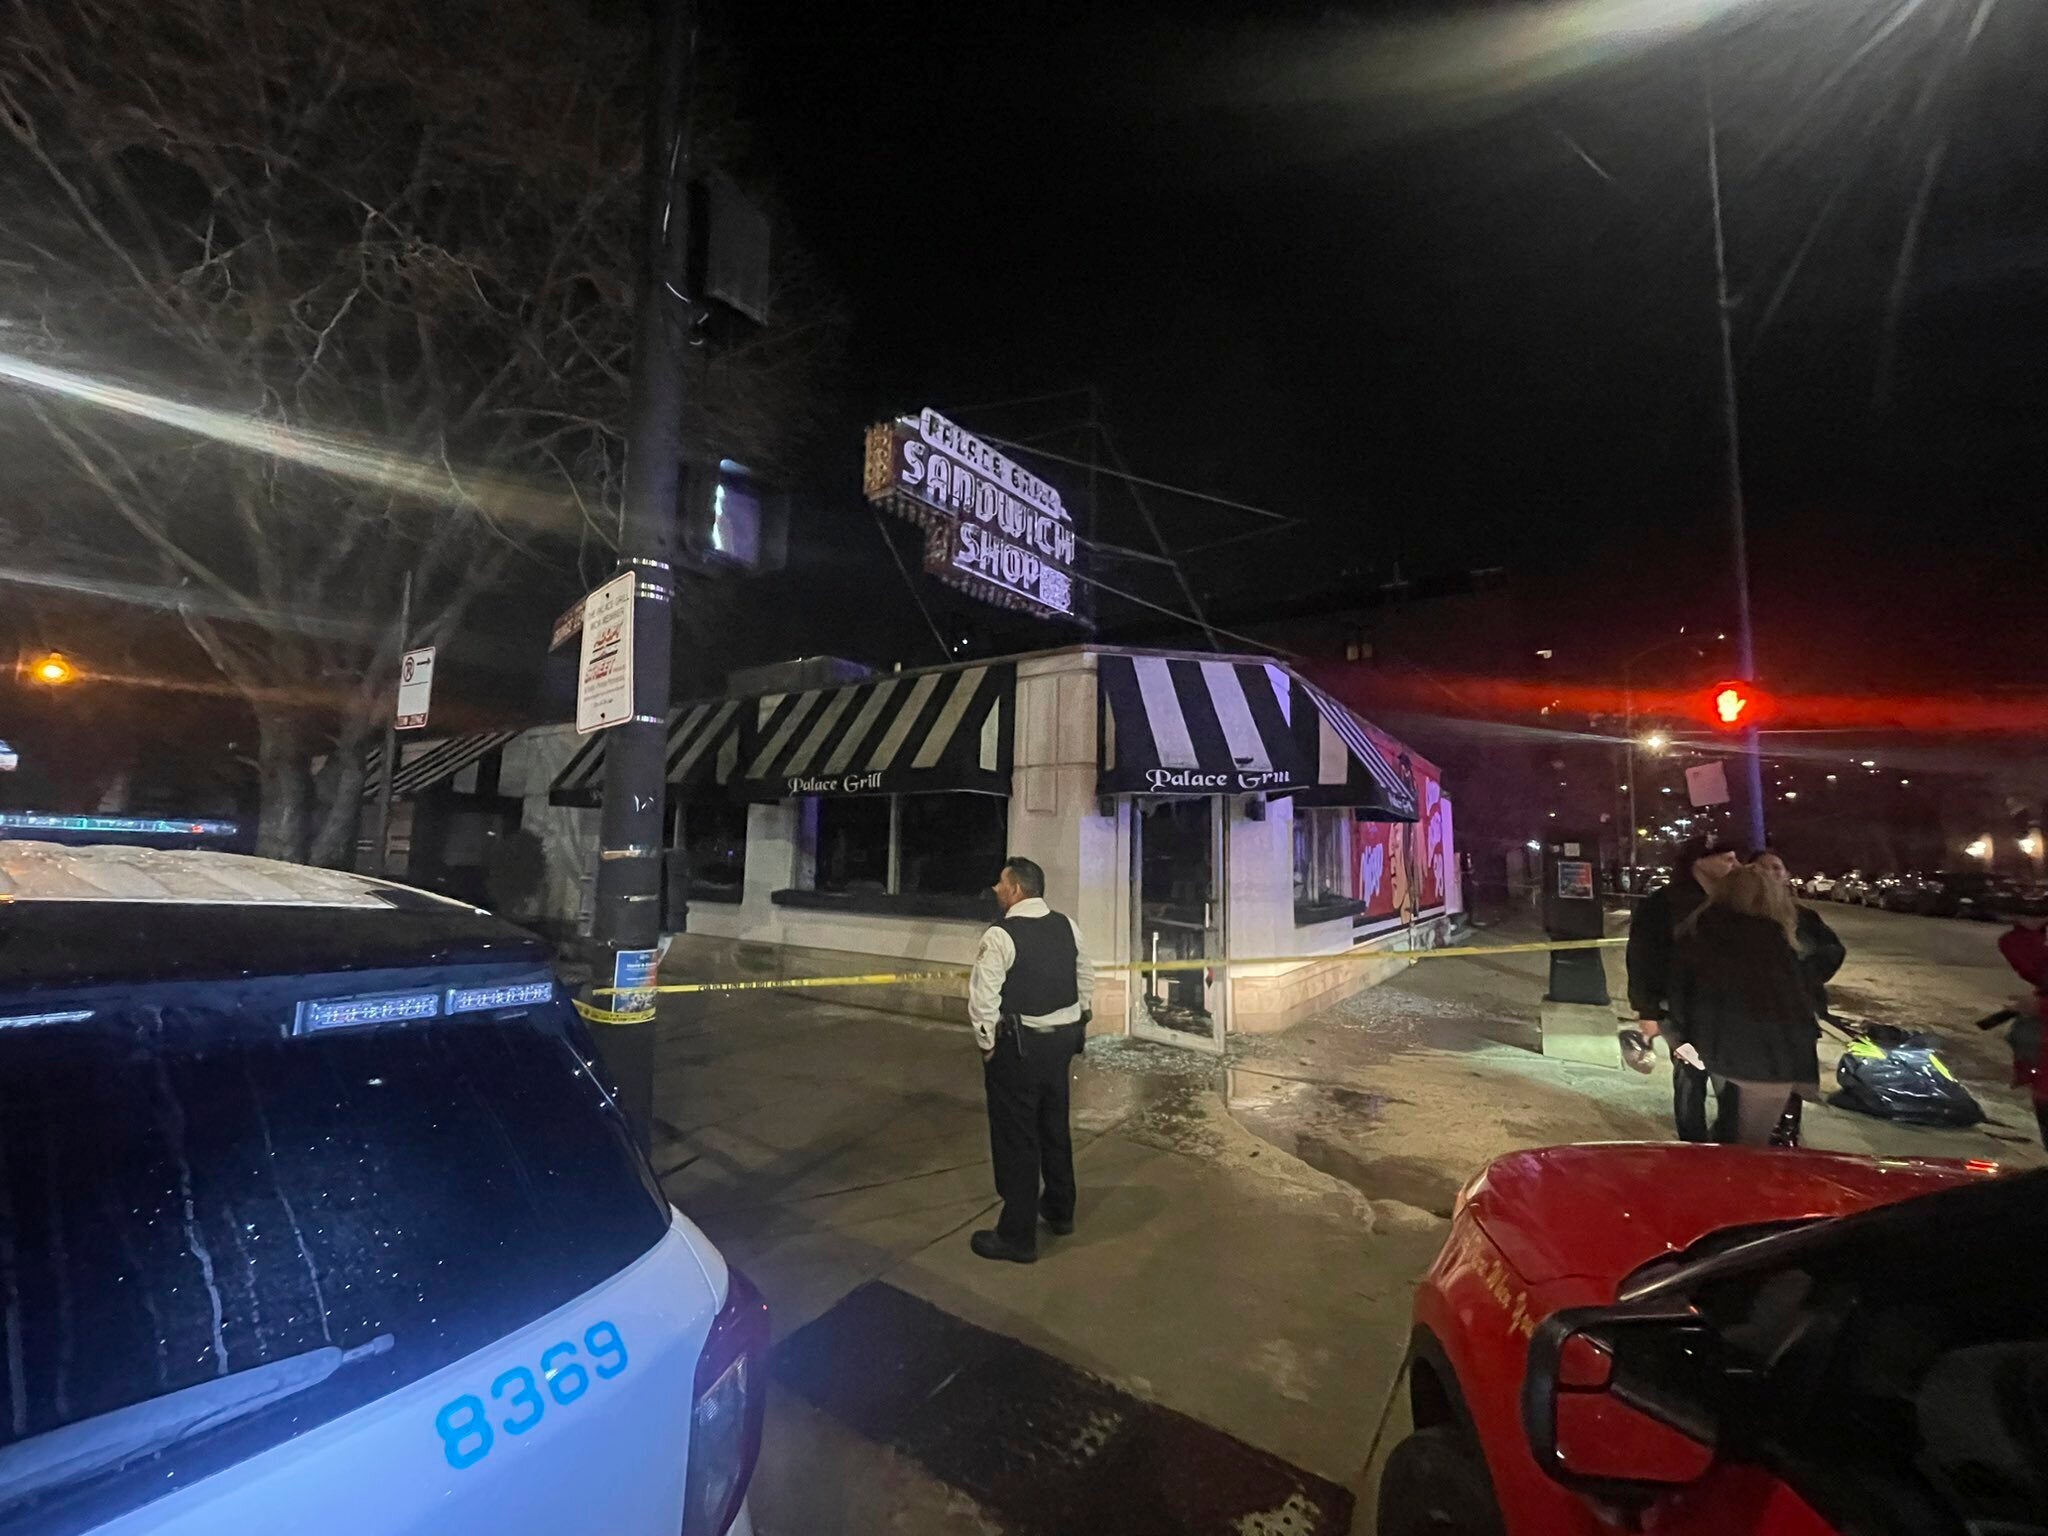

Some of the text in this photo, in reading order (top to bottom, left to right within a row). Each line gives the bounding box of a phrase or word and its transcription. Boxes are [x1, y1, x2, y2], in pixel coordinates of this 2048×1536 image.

[927, 413, 1003, 476] PALACE
[902, 440, 1075, 566] SANDWICH
[958, 523, 1041, 590] SHOP
[788, 772, 882, 798] Palace Grill
[1145, 769, 1291, 793] Palace Grill
[435, 1320, 628, 1471] 8369
